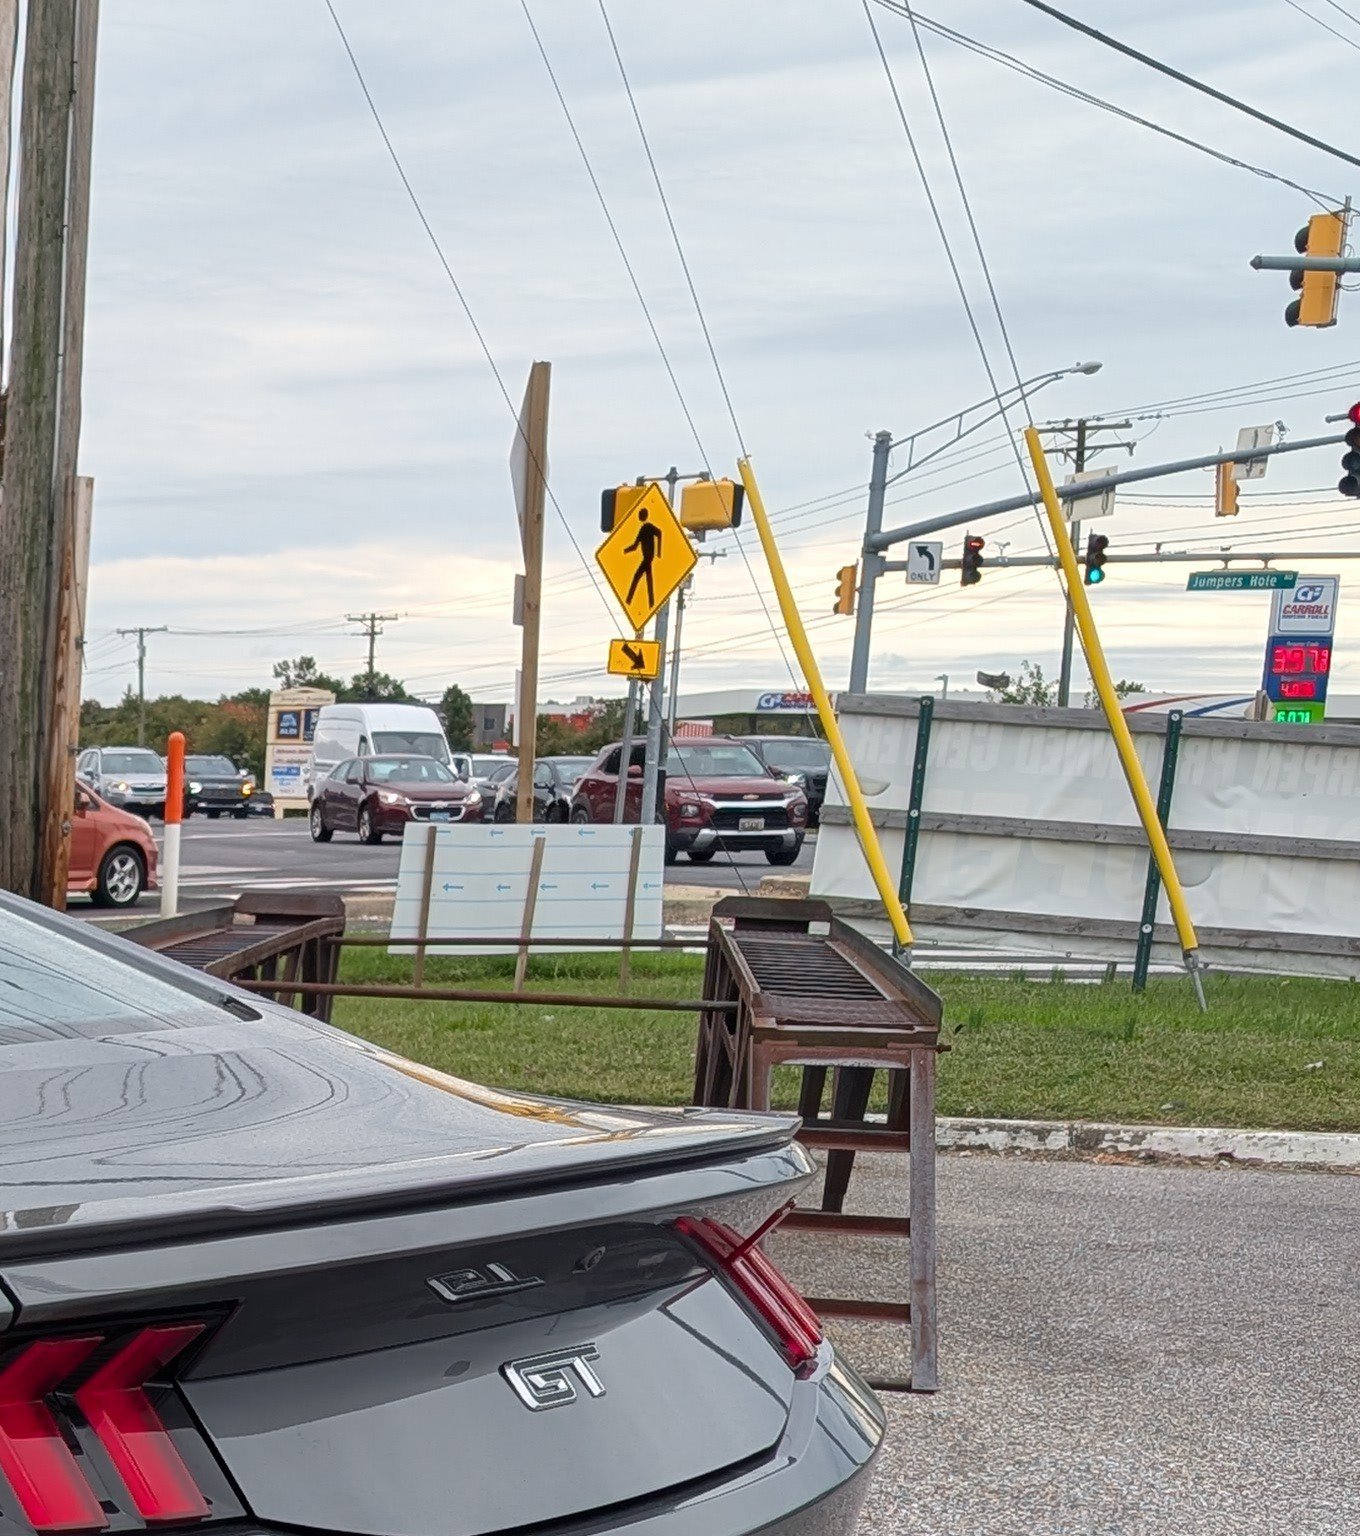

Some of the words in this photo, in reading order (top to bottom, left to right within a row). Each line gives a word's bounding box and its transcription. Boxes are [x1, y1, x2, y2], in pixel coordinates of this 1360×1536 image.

[910, 572, 935, 581] ONLY
[1193, 575, 1243, 589] Jumpers
[1249, 575, 1278, 587] Hole
[1282, 605, 1329, 615] CARROLL
[499, 1342, 606, 1412] GT
